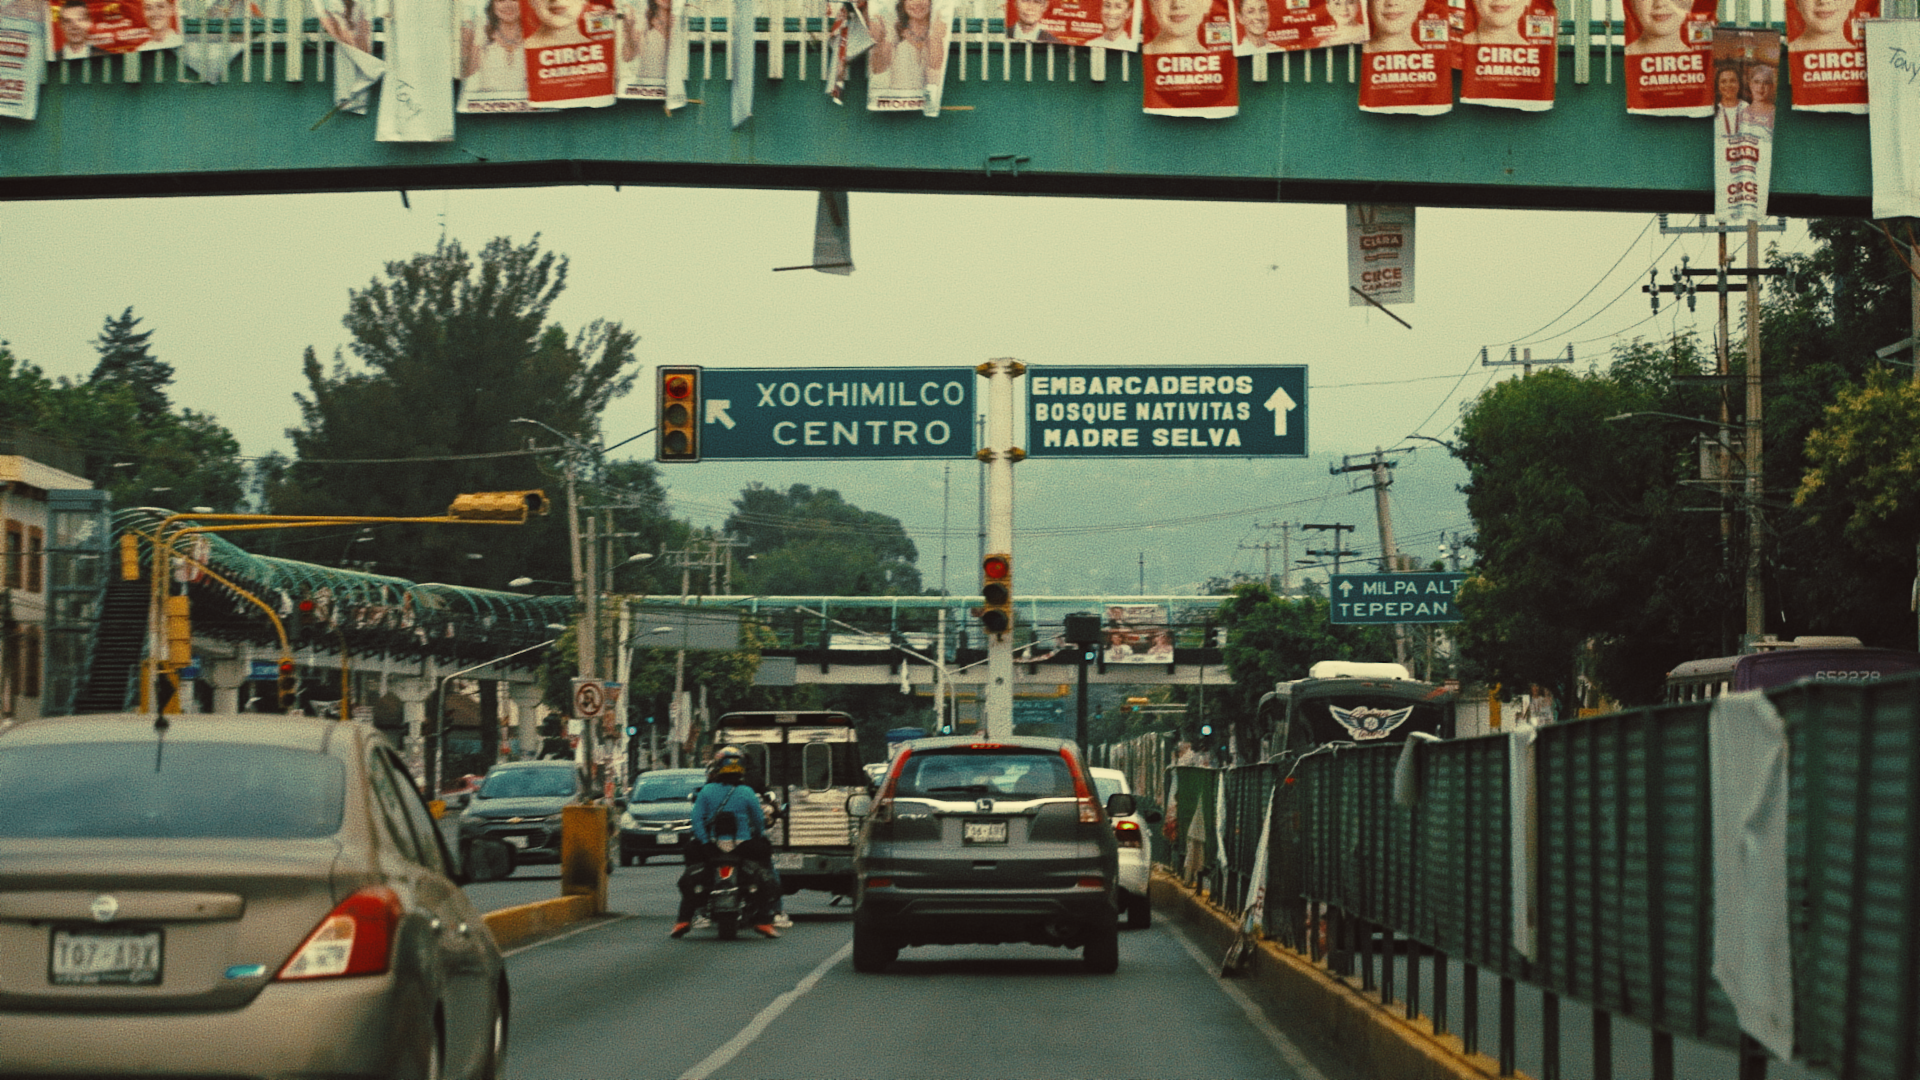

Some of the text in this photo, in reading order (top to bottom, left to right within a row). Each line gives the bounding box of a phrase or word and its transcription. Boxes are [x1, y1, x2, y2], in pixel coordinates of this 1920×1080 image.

[538, 44, 604, 66] CIRCE
[1156, 55, 1221, 73] CIRCE
[1373, 53, 1435, 71] CIRCE
[1478, 46, 1540, 64] CIRCE
[1640, 54, 1704, 73] CIRCE
[1804, 51, 1866, 70] CIRCE
[1155, 73, 1223, 86] CAMACHO
[1371, 72, 1437, 84] CAMACHO
[1475, 65, 1541, 77] CAMACHO
[1639, 72, 1706, 86] CAMACHO
[1803, 69, 1868, 82] CAMACHO
[756, 381, 965, 407] XOCHIMILCO
[1031, 375, 1253, 396] EMBARCADEROS
[1035, 401, 1251, 424] BOSQUE NATIVITAS
[772, 420, 951, 446] CENTRO
[1043, 427, 1242, 447] MADRE SELVA
[1363, 579, 1462, 595] MILPA ALT
[1338, 601, 1448, 617] TEPEPAN
